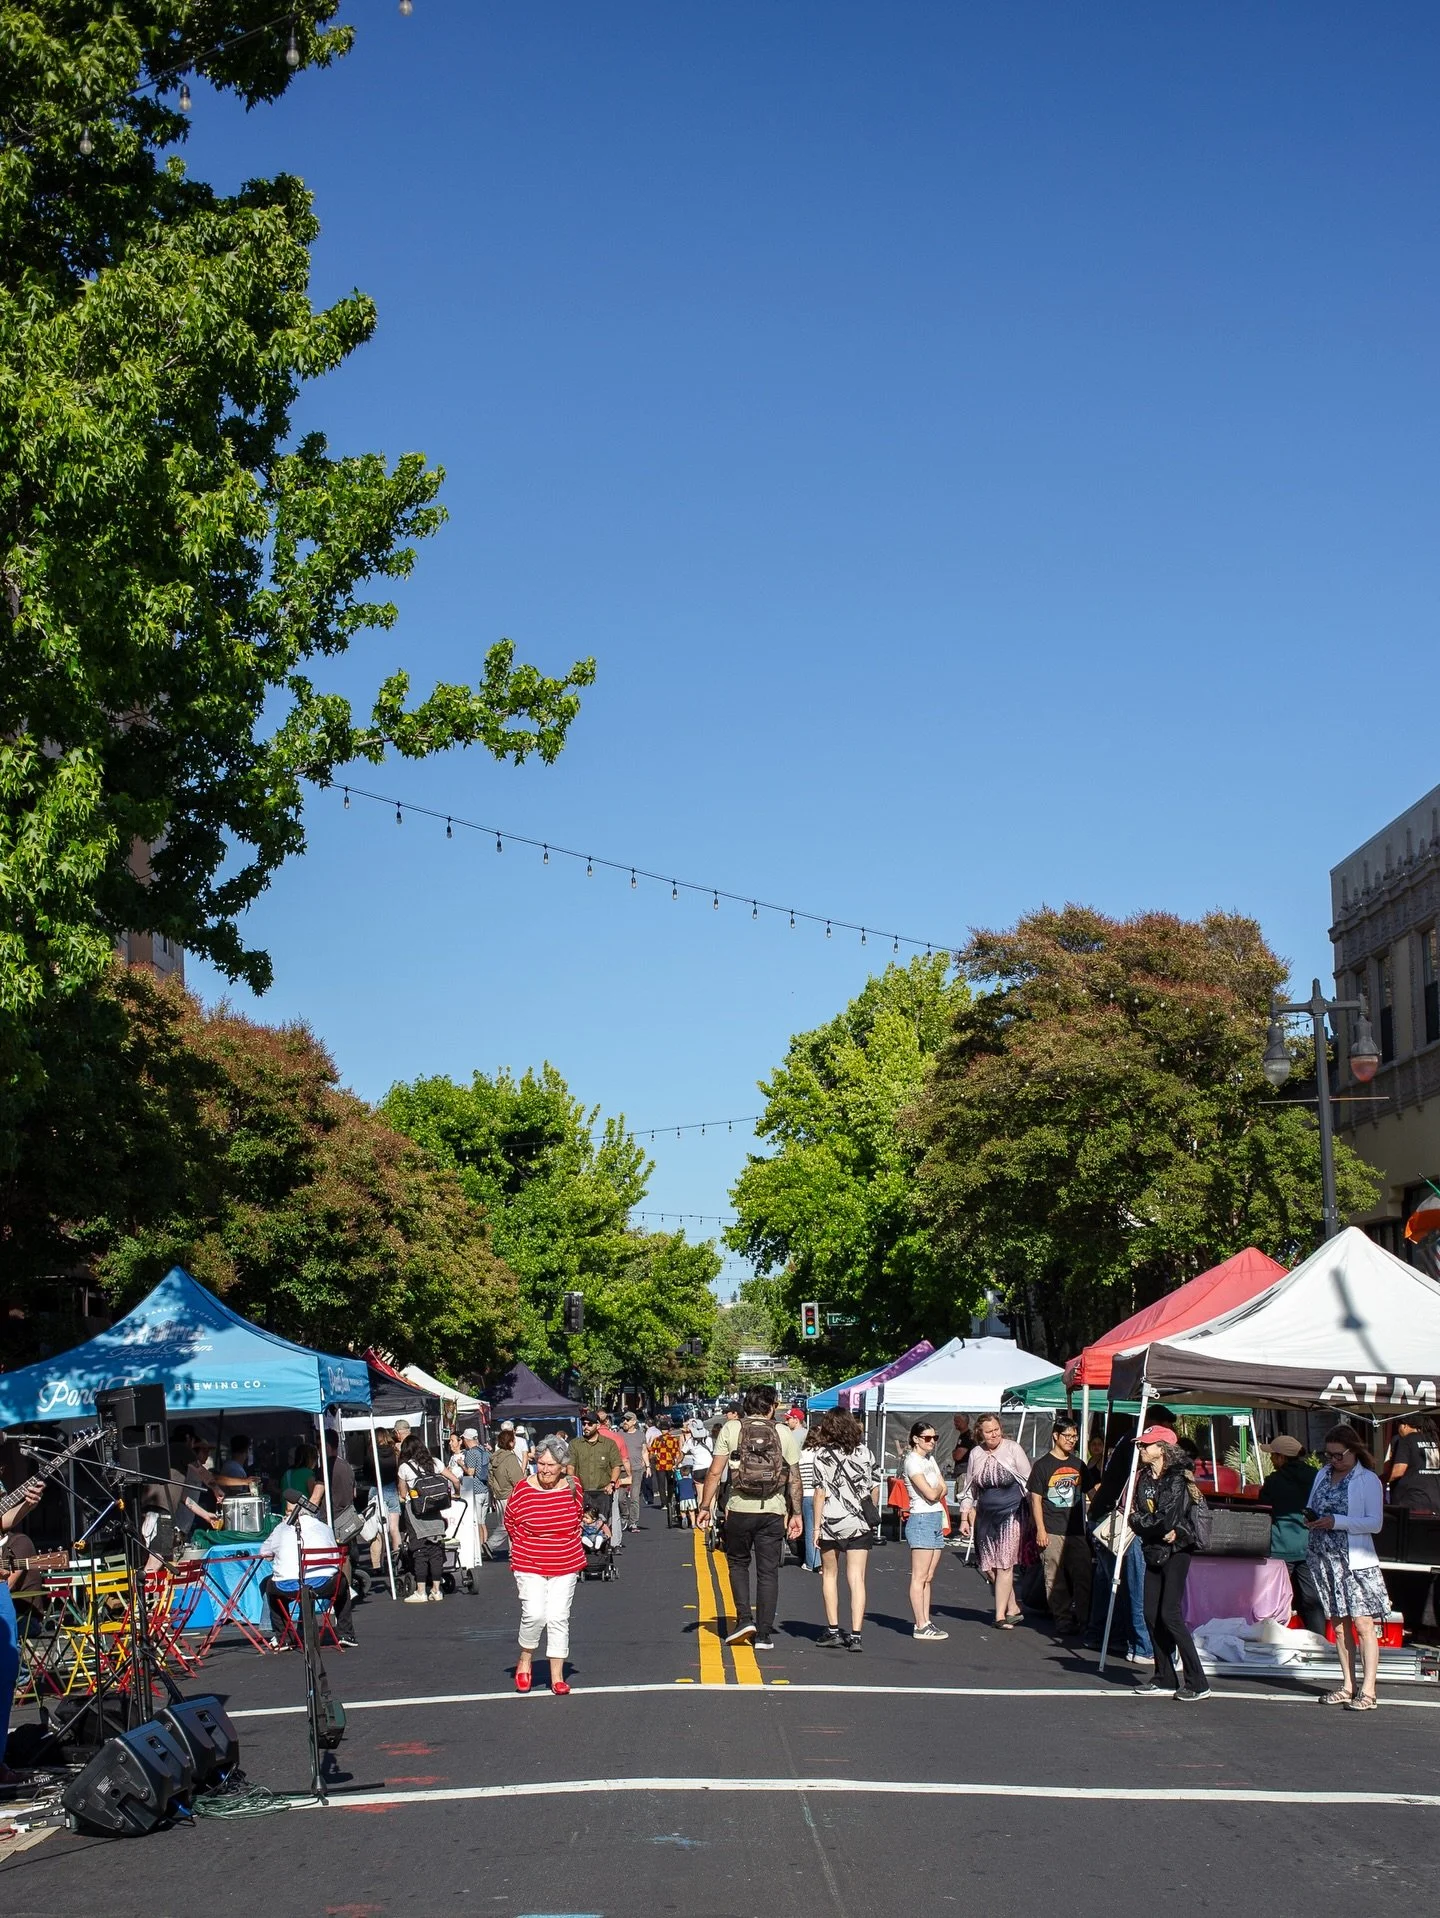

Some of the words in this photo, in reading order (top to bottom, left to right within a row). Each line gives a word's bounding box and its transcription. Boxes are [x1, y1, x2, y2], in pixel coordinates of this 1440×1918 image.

[175, 1381, 239, 1392] BREWING
[243, 1380, 266, 1389] CO.
[1319, 1375, 1437, 1406] ATM
